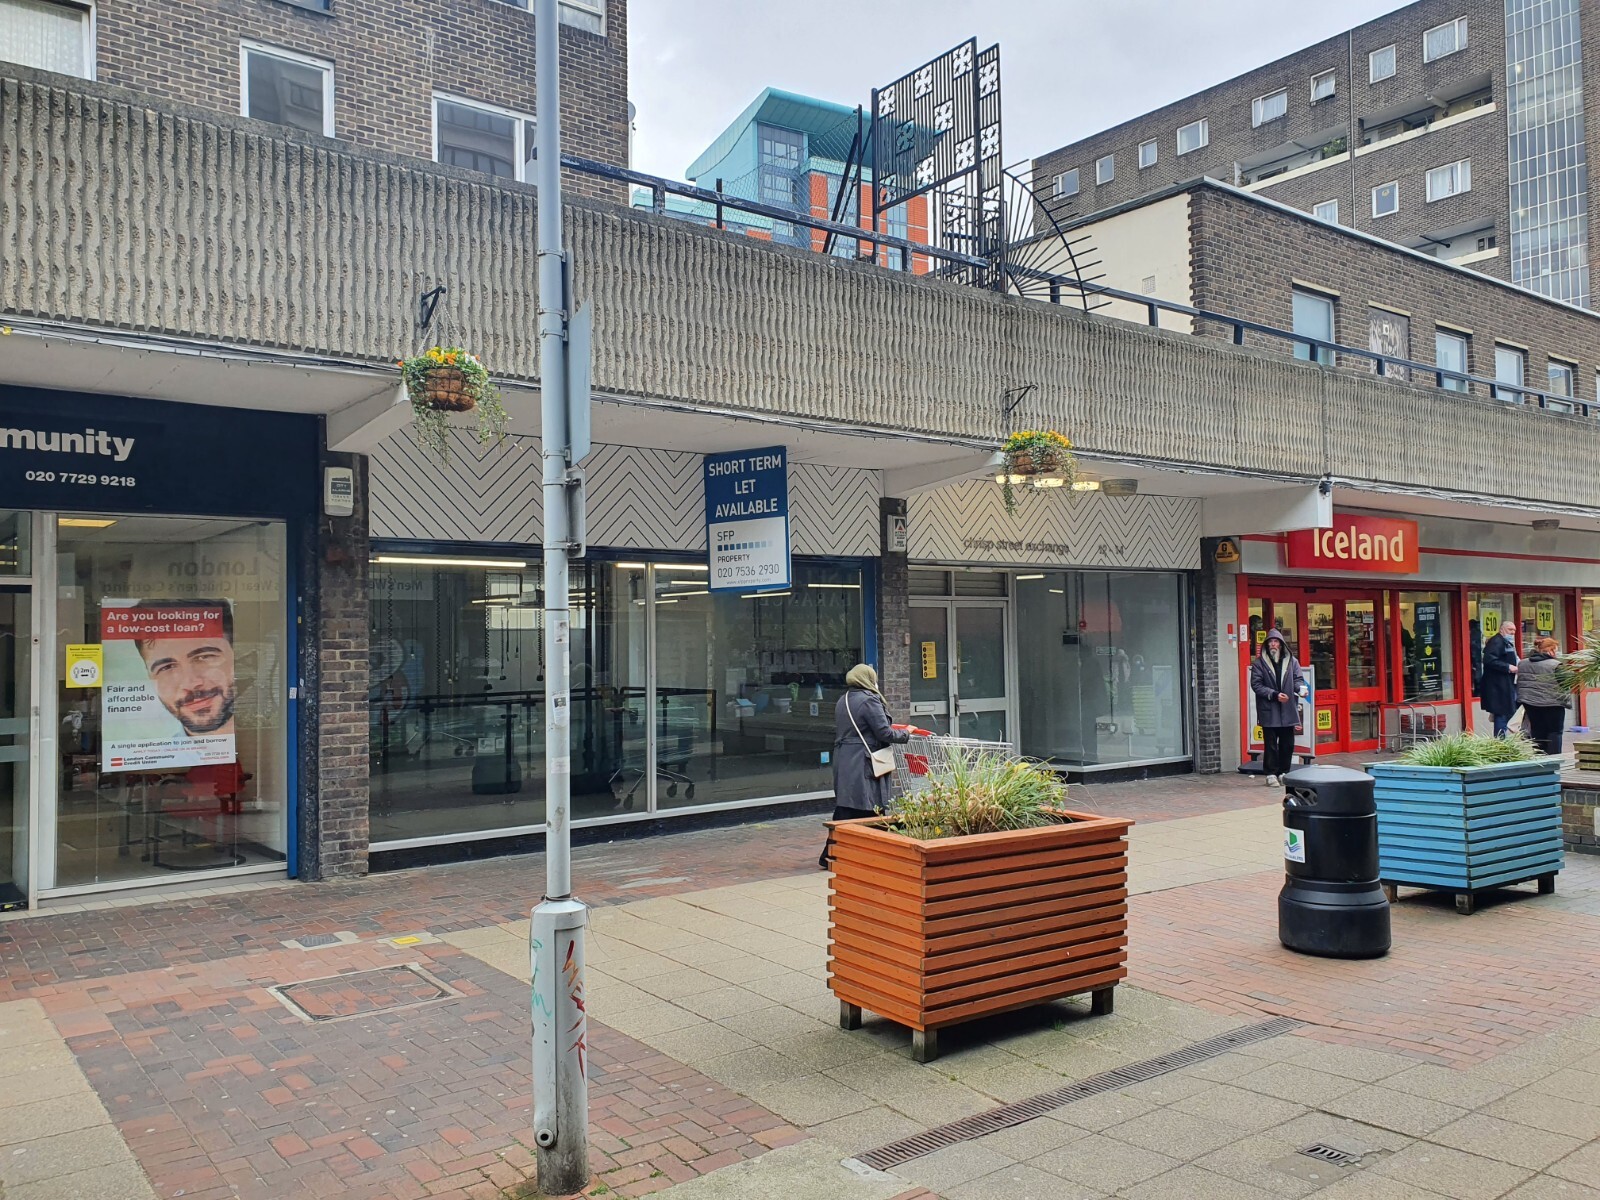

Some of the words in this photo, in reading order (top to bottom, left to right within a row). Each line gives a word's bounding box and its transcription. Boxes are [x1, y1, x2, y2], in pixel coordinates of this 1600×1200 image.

[708, 459, 746, 477] SHORT
[749, 454, 782, 472] TERM
[25, 471, 55, 482] 020
[59, 472, 97, 485] 7729
[100, 475, 136, 487] 9218
[735, 479, 756, 495] LET
[715, 498, 778, 518] AVAILABLE
[717, 530, 735, 542] SFP
[963, 537, 994, 552] chrisp
[996, 539, 1024, 551] street
[1025, 541, 1070, 556] exchange
[1314, 525, 1404, 562] Iceland
[717, 554, 751, 563] PROPERTY
[717, 567, 733, 579] 020
[735, 565, 756, 577] 7536
[758, 563, 780, 575] 2930
[107, 612, 128, 621] Are
[132, 613, 154, 622] you
[157, 611, 200, 622] looking
[203, 611, 219, 620] for
[118, 624, 170, 633] low-cost
[173, 623, 205, 632] loan?
[1485, 616, 1497, 632] £10
[106, 685, 125, 693] Fair
[127, 684, 145, 692] and
[107, 694, 155, 703] affordable
[107, 705, 142, 713] finance
[118, 742, 136, 750] single
[137, 740, 172, 748] application
